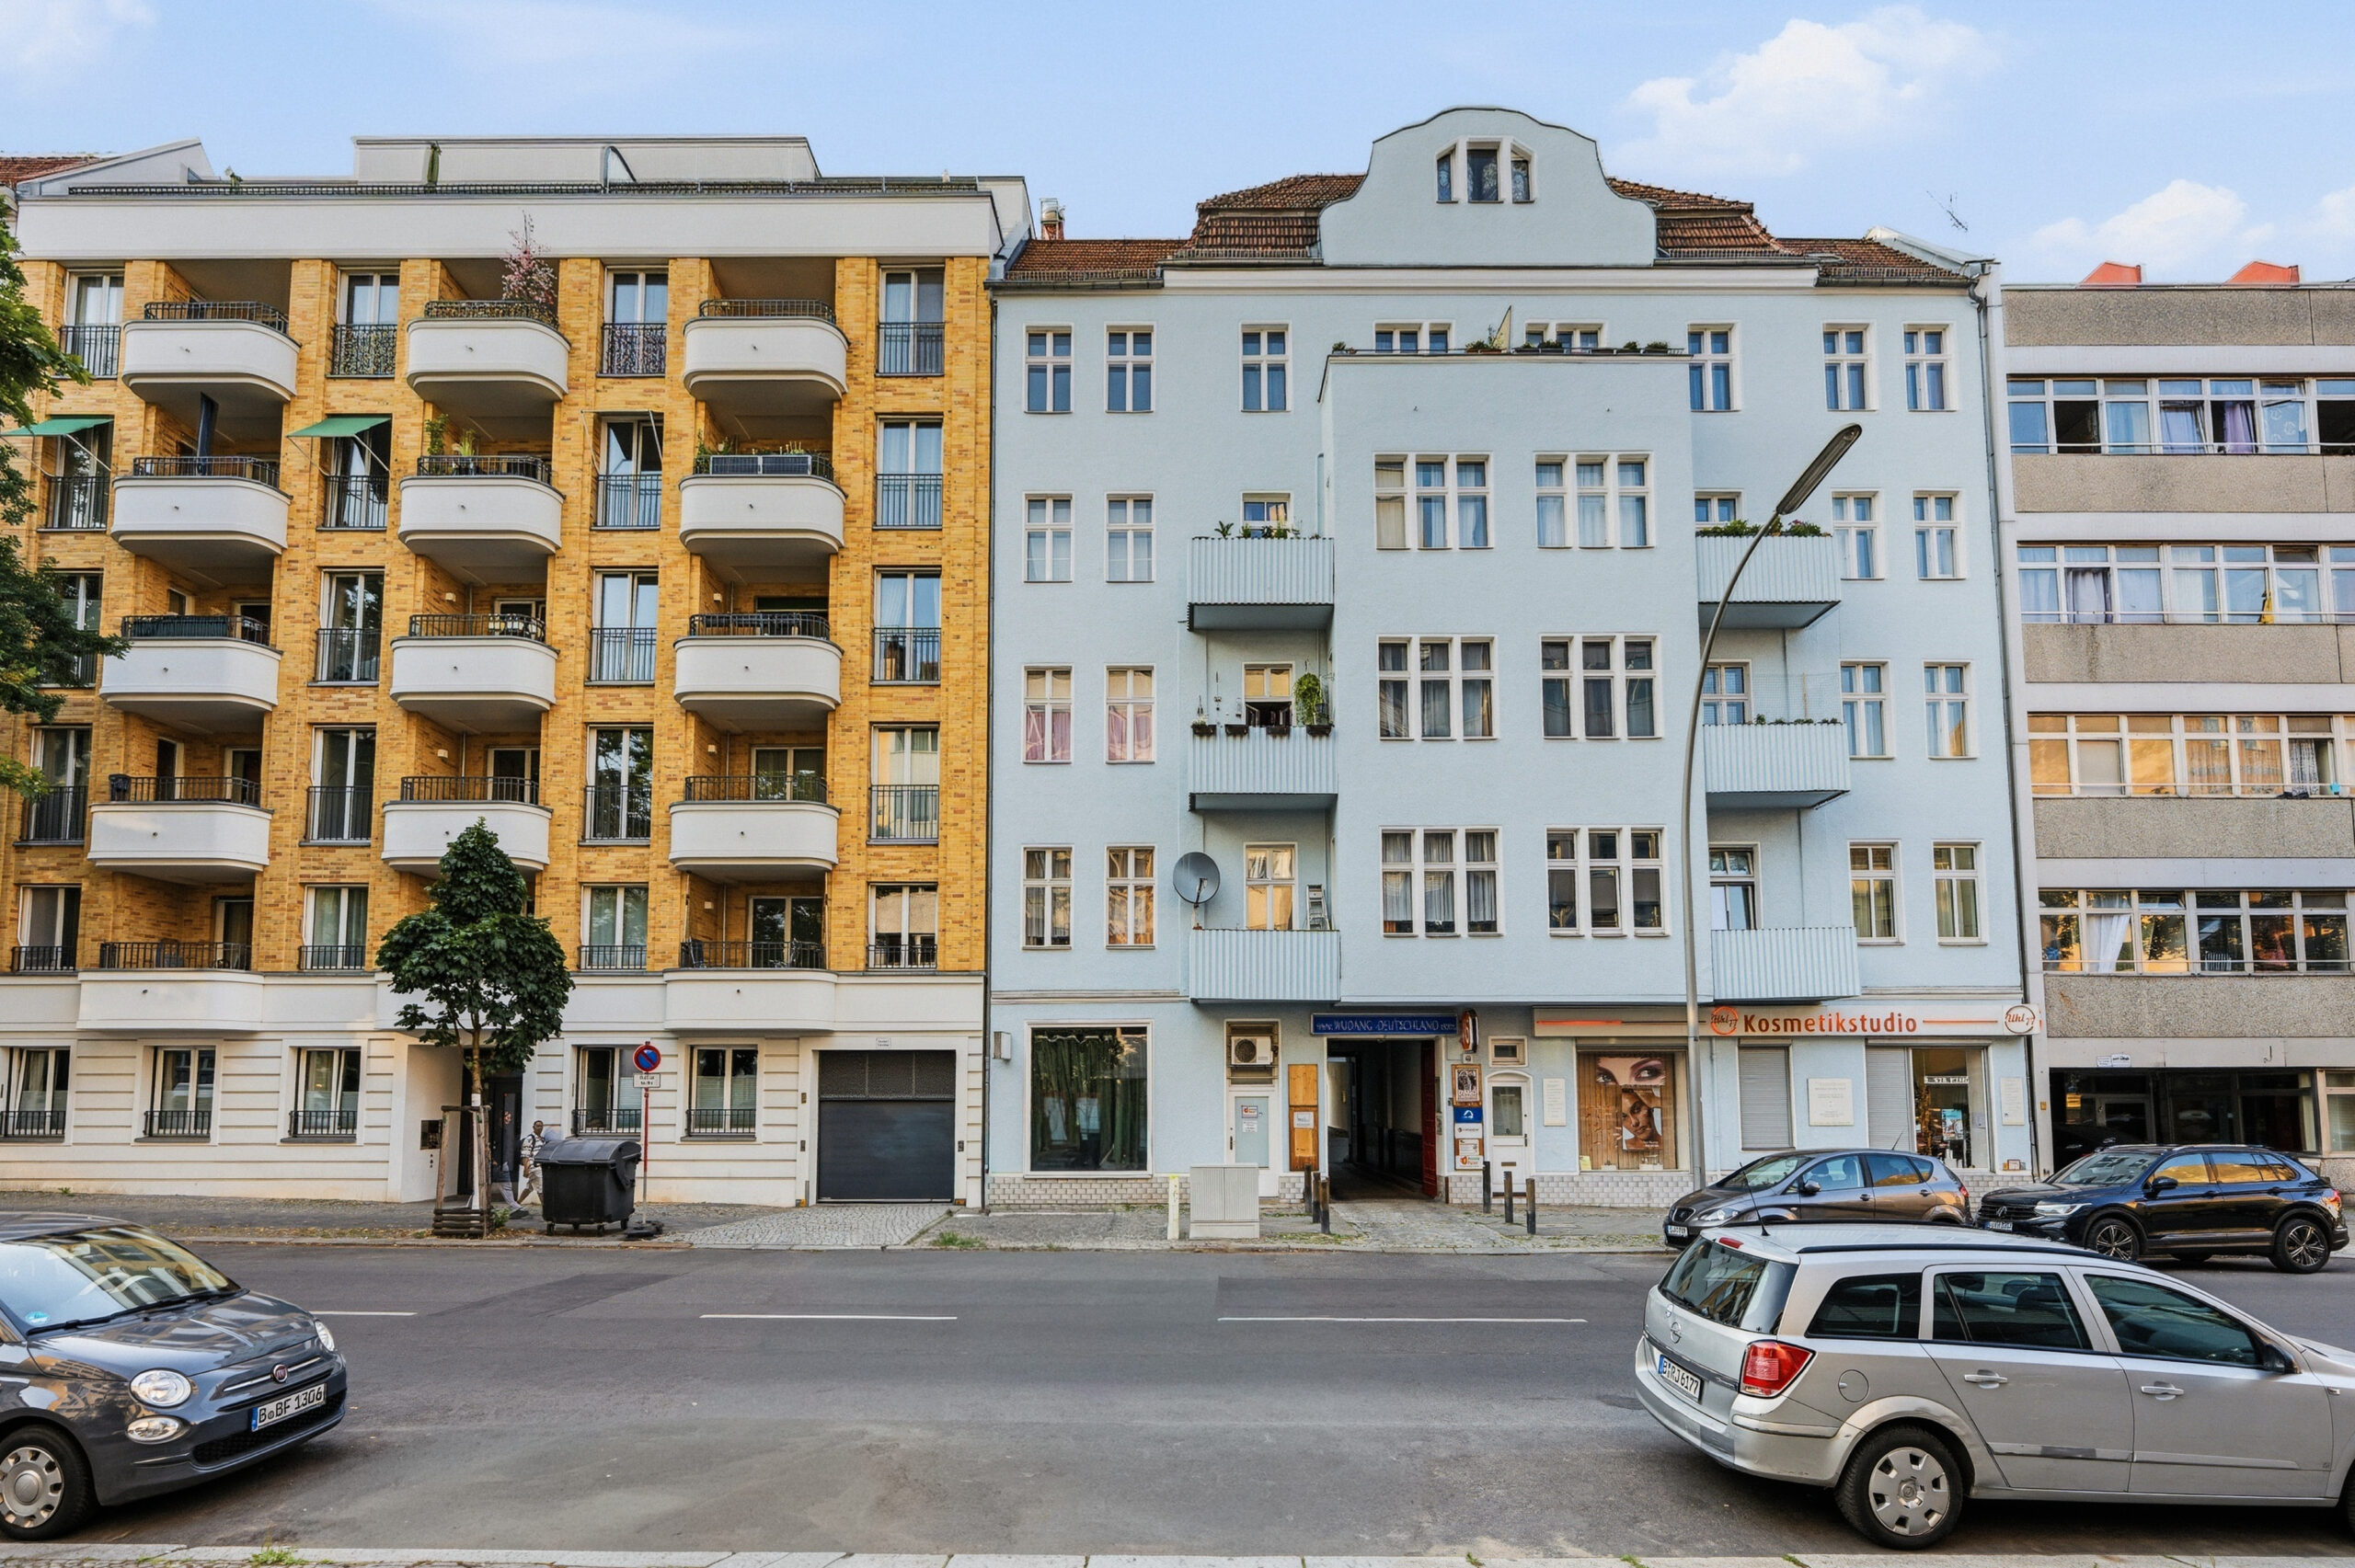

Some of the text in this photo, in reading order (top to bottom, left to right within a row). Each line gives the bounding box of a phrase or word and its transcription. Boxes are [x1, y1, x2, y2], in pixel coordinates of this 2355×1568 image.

[1743, 1013, 1917, 1033] Kosmetikstudio
[1670, 1366, 1681, 1382] RJ
[1681, 1373, 1699, 1394] 6177
[258, 1387, 322, 1424] B BF 1306
